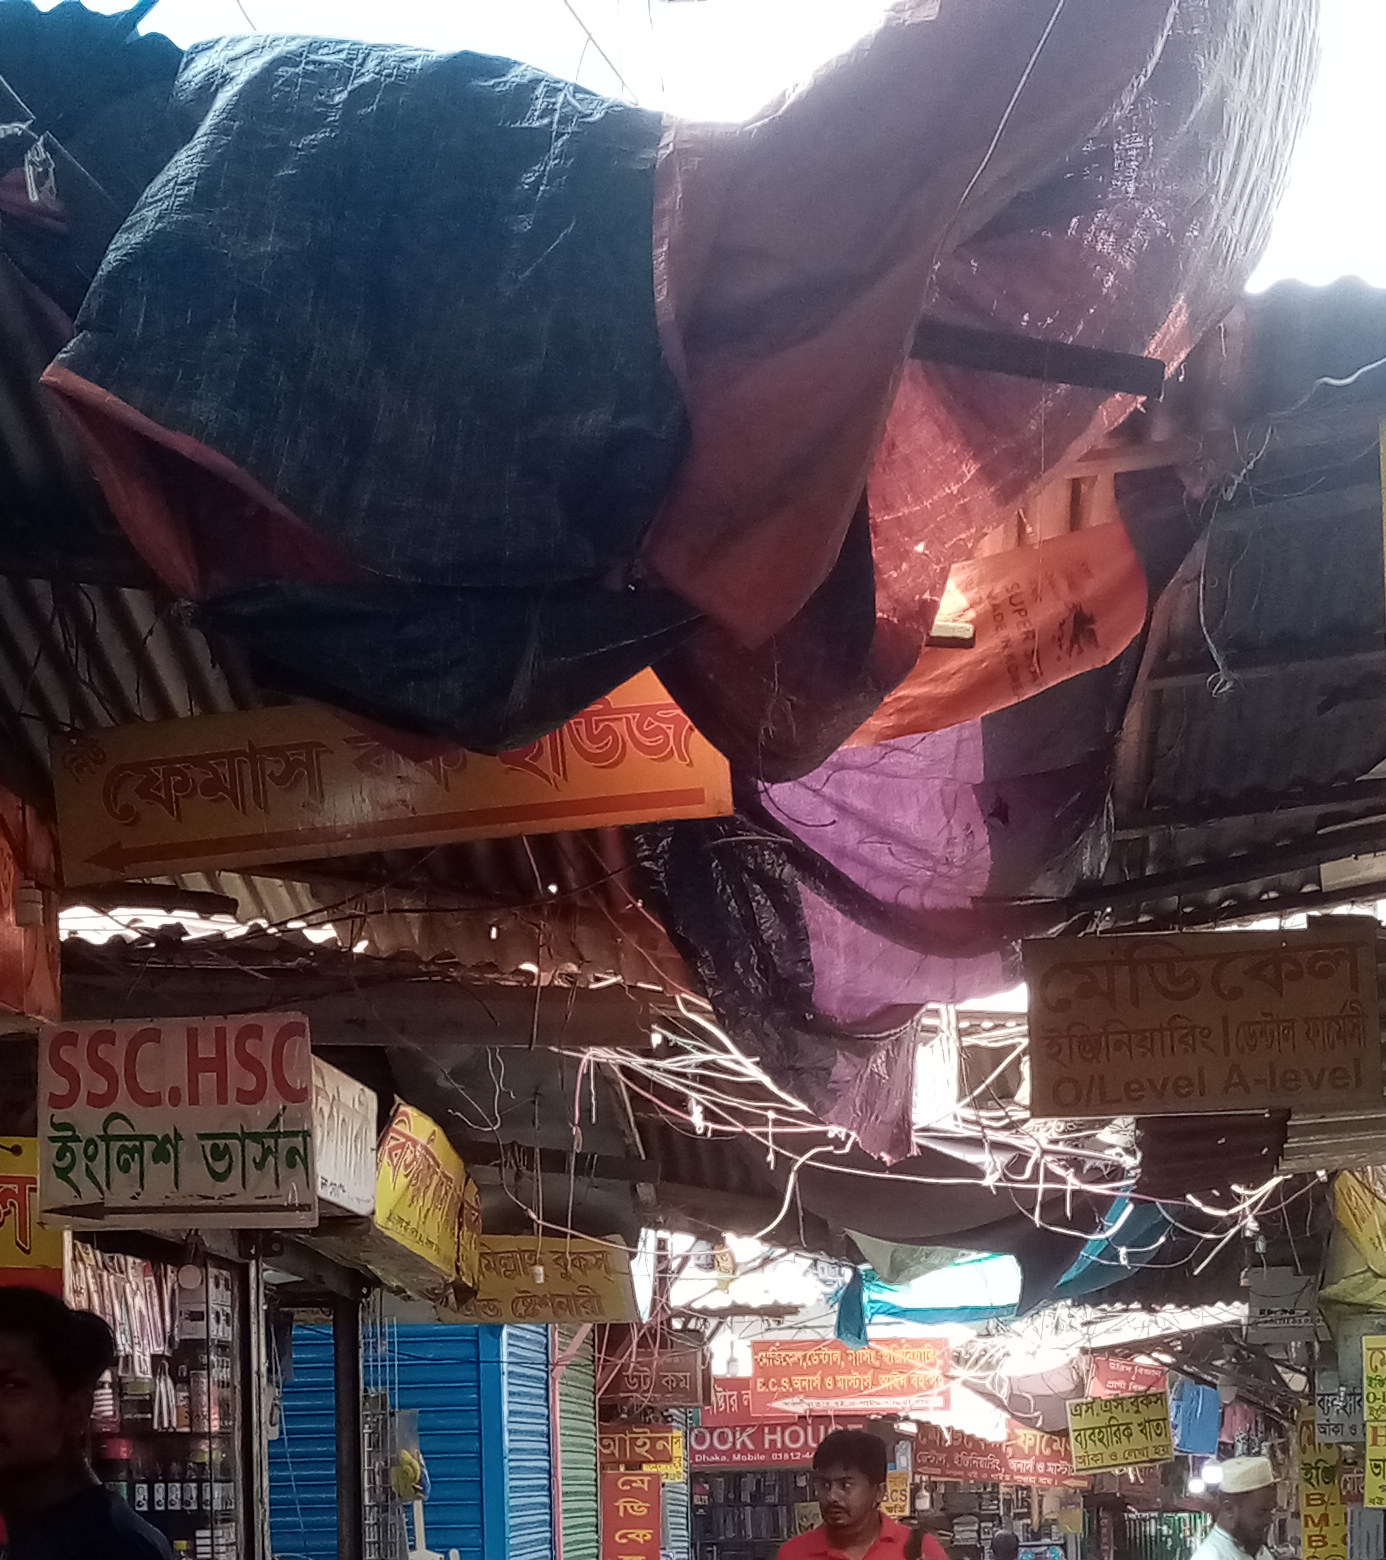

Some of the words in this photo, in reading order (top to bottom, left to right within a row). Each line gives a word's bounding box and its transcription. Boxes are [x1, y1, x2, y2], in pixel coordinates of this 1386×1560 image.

[1039, 939, 1369, 1013] মেডিকেল
[47, 1021, 308, 1110] SSC.HSC
[48, 1111, 185, 1199] ইংলিশ
[196, 1105, 312, 1193] ভার্সন
[599, 1424, 673, 1462] আইন
[690, 1426, 758, 1451] OOK
